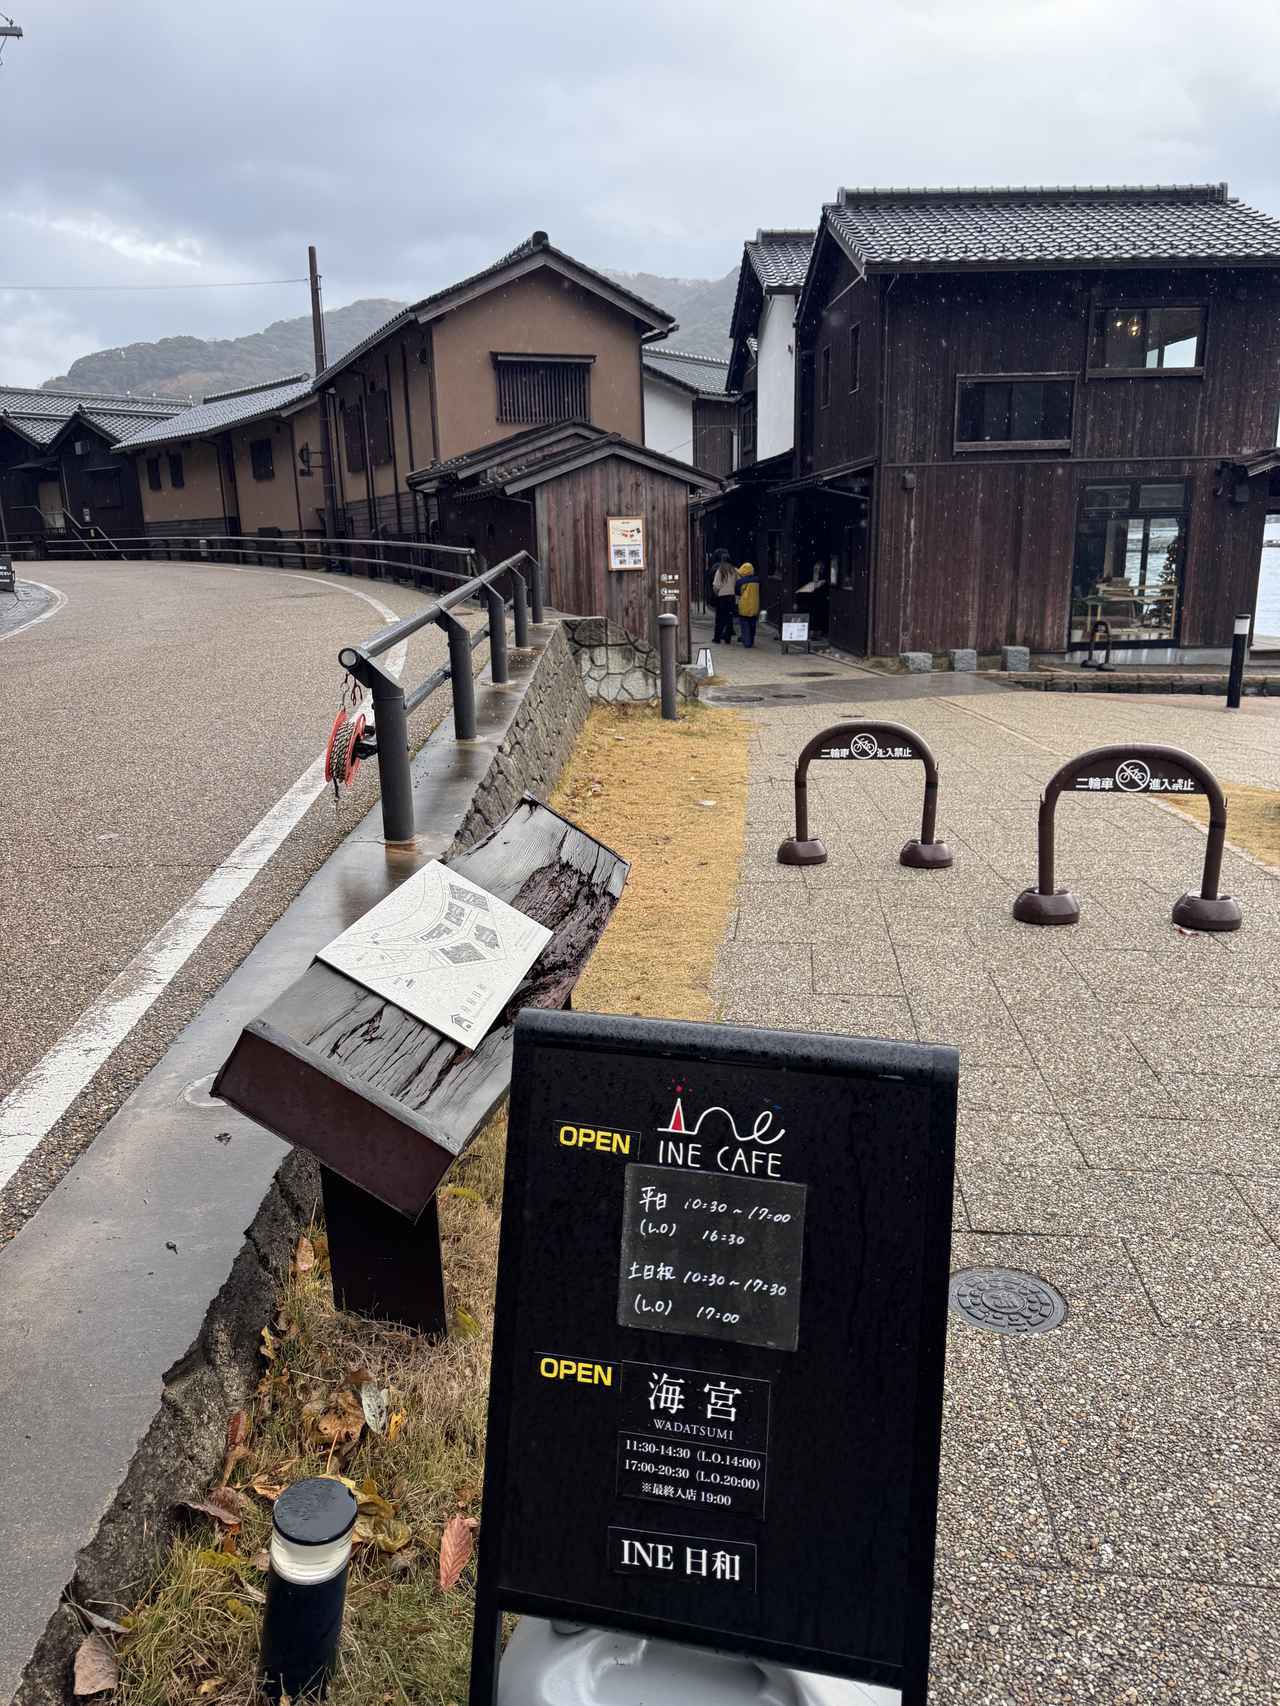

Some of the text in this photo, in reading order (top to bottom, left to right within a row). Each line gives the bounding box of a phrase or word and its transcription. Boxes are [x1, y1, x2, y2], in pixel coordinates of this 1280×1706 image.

[821, 748, 850, 758] 二輪車
[1075, 777, 1195, 791] 二輪車 進入禁止
[559, 1125, 631, 1154] OPEN
[658, 1140, 782, 1178] INE CAFE
[639, 1186, 667, 1213] 平日
[702, 1230, 745, 1245] 16:30
[628, 1261, 676, 1281] 土日祝
[696, 1306, 740, 1324] 17:00
[540, 1357, 612, 1386] OPEN
[653, 1418, 734, 1441] WADATSUMI
[625, 1439, 761, 1471] 11:30-14:30 (L.O.14:00)
[624, 1459, 760, 1491] 17:00-20:30 (L.O.20:00)
[700, 1491, 732, 1506] 19:00
[620, 1539, 741, 1581] INE 日和
